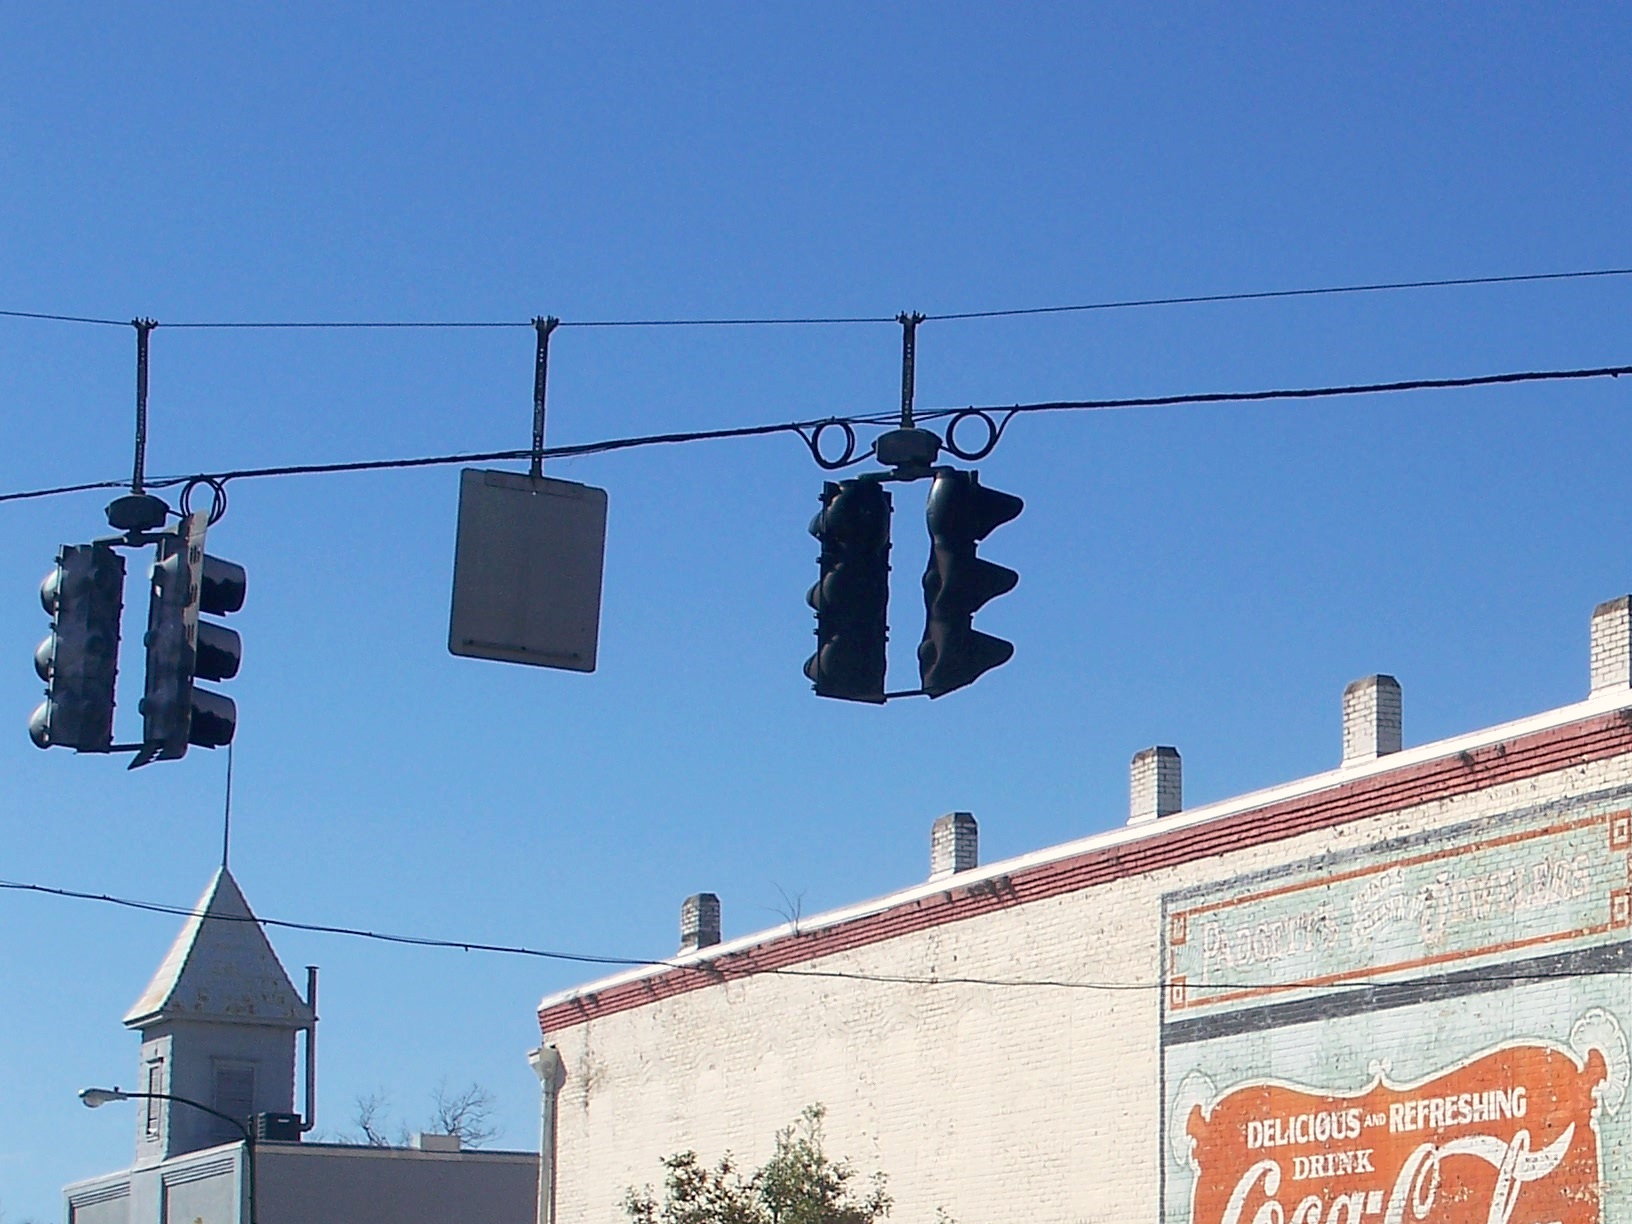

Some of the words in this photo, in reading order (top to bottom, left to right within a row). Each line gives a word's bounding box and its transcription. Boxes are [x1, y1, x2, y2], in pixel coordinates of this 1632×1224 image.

[1247, 1108, 1363, 1149] DELICIOUS
[1363, 1113, 1387, 1128] AND
[1389, 1087, 1528, 1133] REFRESHING
[1292, 1149, 1376, 1180] DRINK
